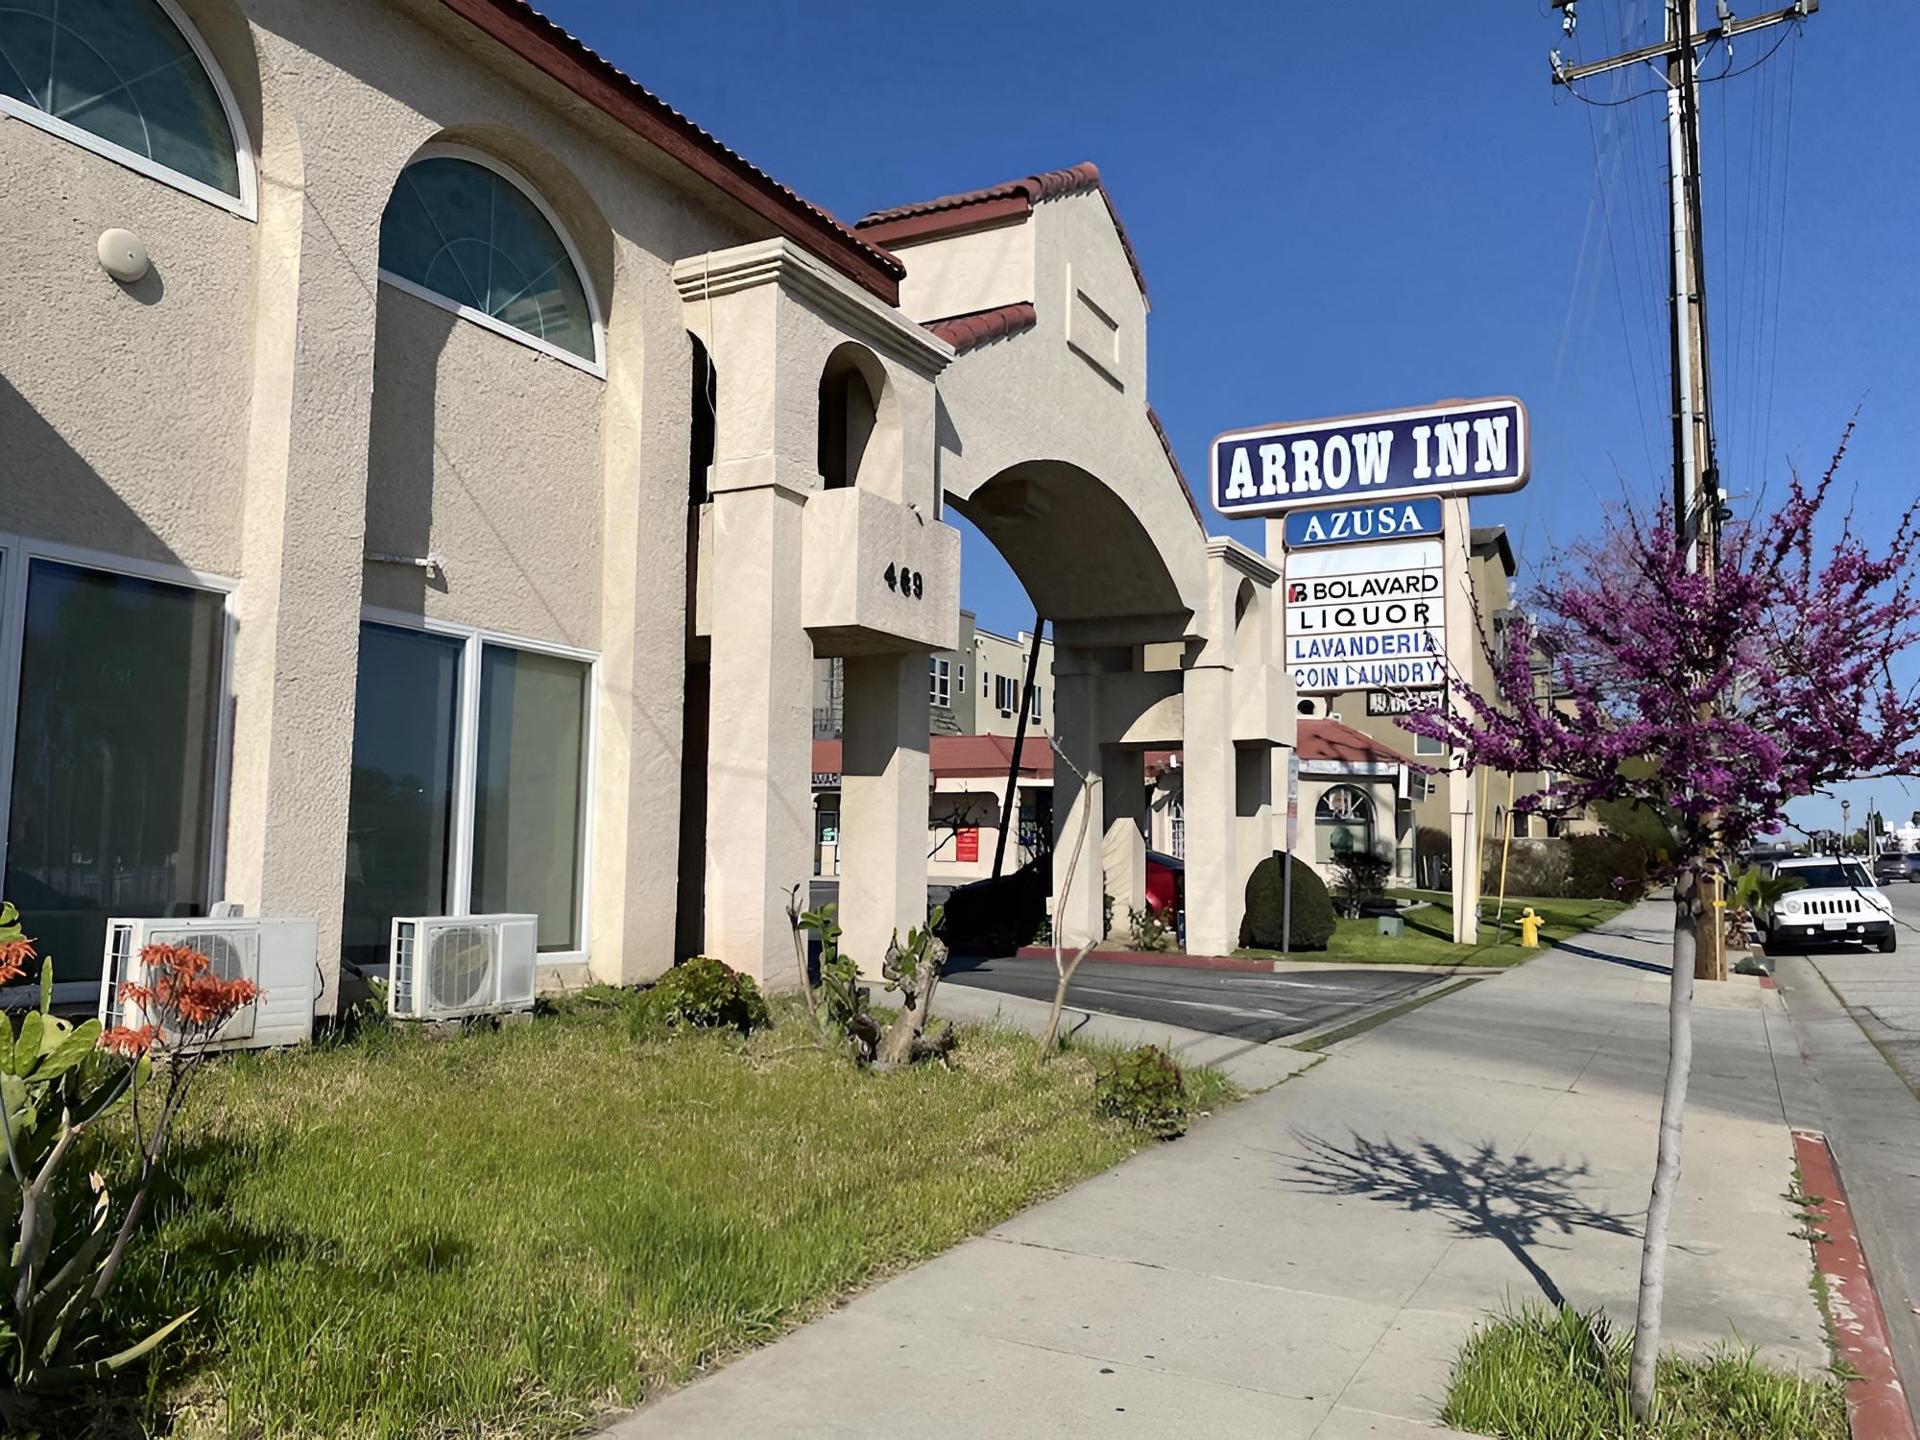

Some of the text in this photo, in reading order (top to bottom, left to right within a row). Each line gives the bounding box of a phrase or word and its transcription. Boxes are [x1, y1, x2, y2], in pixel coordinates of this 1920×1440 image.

[1226, 416, 1509, 499] ARROW INN
[1303, 505, 1424, 542] AZUSA
[1313, 574, 1438, 600] BOLAVARD
[1301, 603, 1430, 629] LIQUOR
[1295, 632, 1436, 659] LAVANDERIA
[1294, 661, 1439, 687] COIN LAUNDRY
